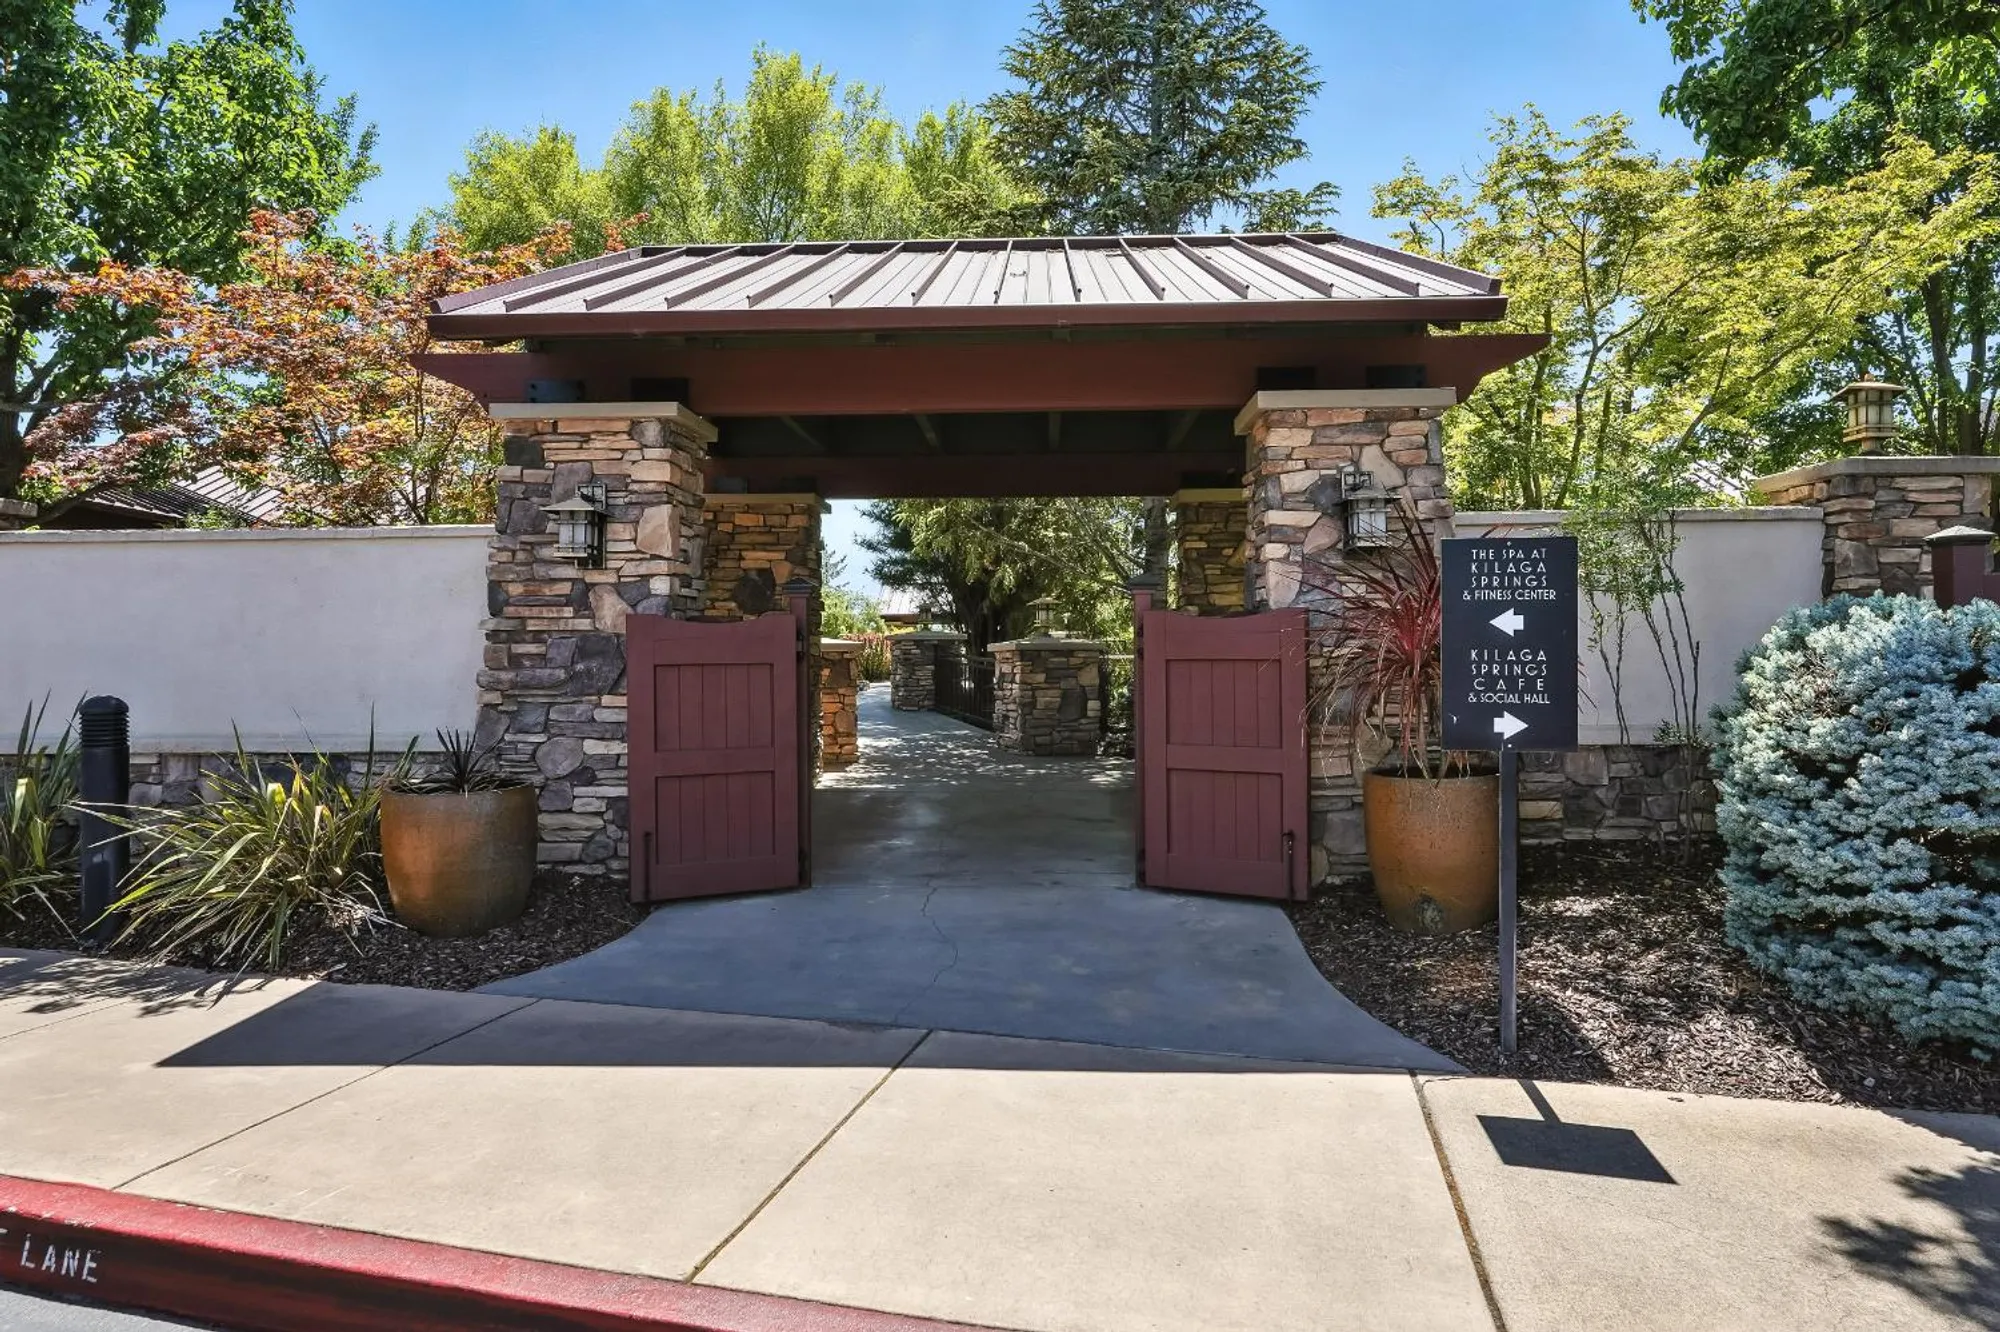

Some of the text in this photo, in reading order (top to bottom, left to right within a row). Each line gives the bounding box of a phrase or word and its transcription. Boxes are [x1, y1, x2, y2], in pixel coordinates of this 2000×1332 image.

[1471, 548, 1547, 559] THE SPA AT
[1471, 561, 1547, 574] KILAGA
[1471, 575, 1547, 588] SPRINGS
[1462, 589, 1556, 600] & FITNESS CENTER
[1471, 649, 1547, 662] KILAGA
[1471, 663, 1547, 676] SPRINGS
[1473, 678, 1545, 691] CAFE
[1468, 693, 1550, 704] & SOCIAL HALL
[20, 1233, 101, 1283] LANE
